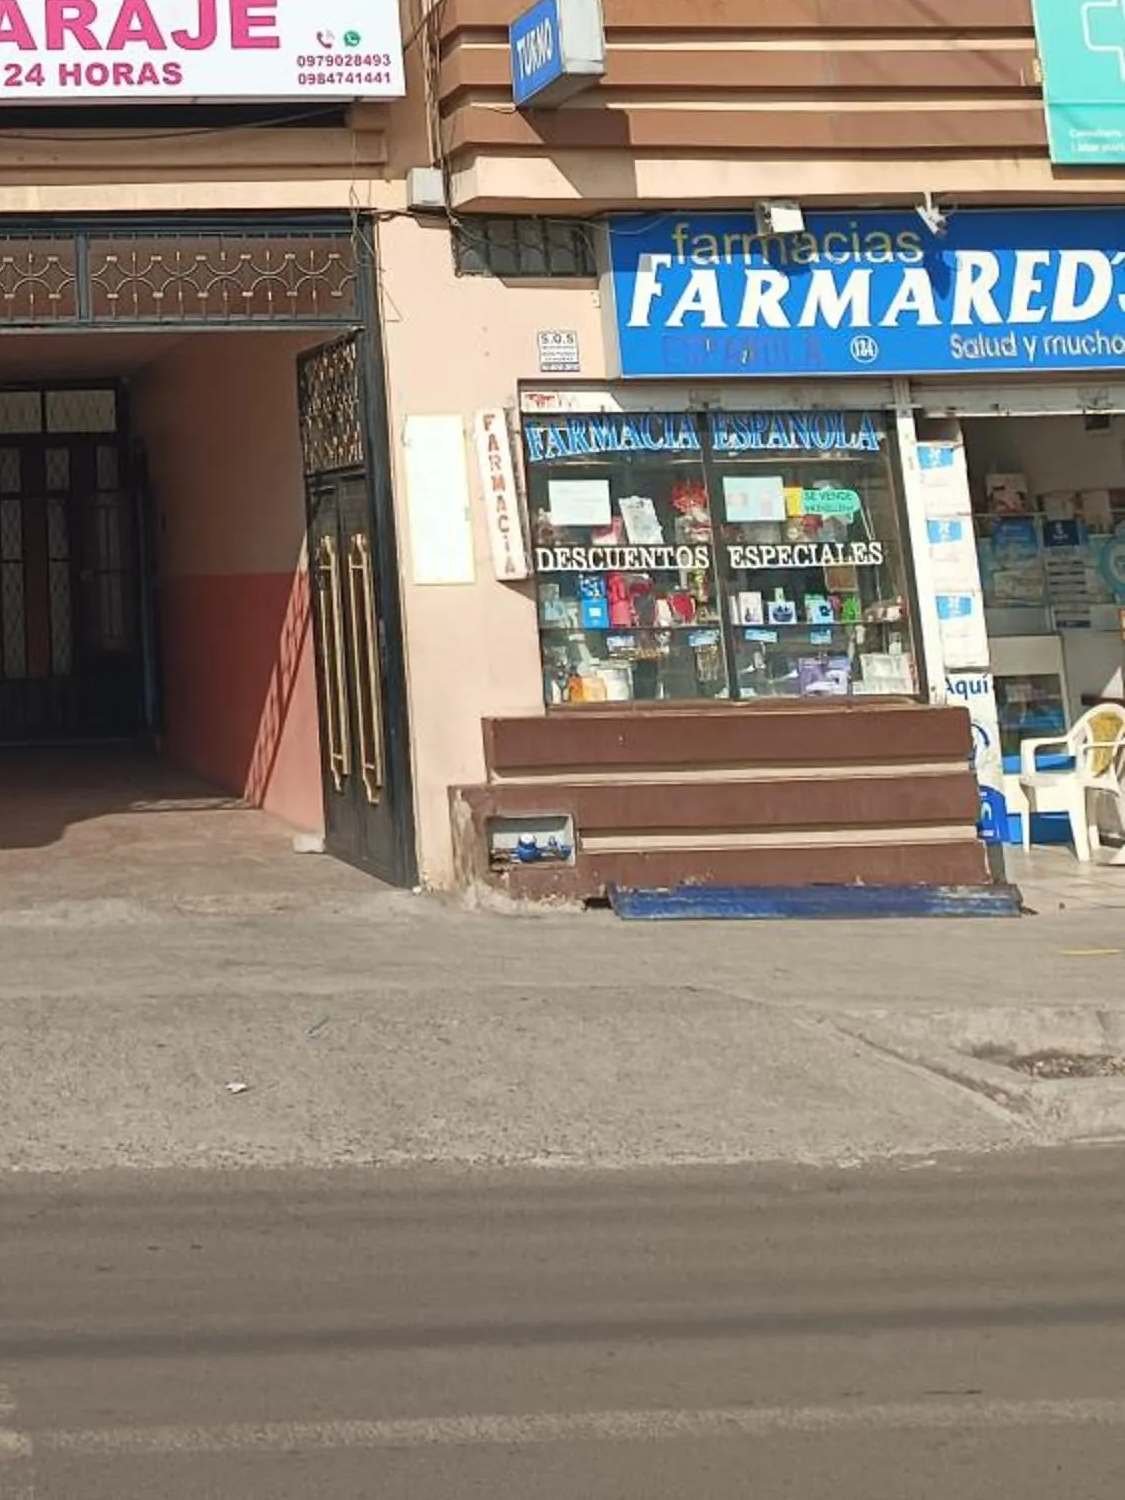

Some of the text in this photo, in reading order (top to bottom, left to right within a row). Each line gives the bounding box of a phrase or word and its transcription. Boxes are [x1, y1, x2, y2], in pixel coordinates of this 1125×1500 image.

[3, 61, 184, 87] 24 HORAS
[297, 53, 392, 68] 0979028493
[298, 71, 391, 85] 0984741441
[672, 222, 924, 266] farmacias
[627, 249, 1125, 328] FARMARED'
[950, 329, 1125, 363] Salud y mucho
[526, 412, 701, 462] FARMACIA
[481, 413, 516, 574] FARMACIA
[535, 541, 884, 572] DESCUENTOS ESPECIALES
